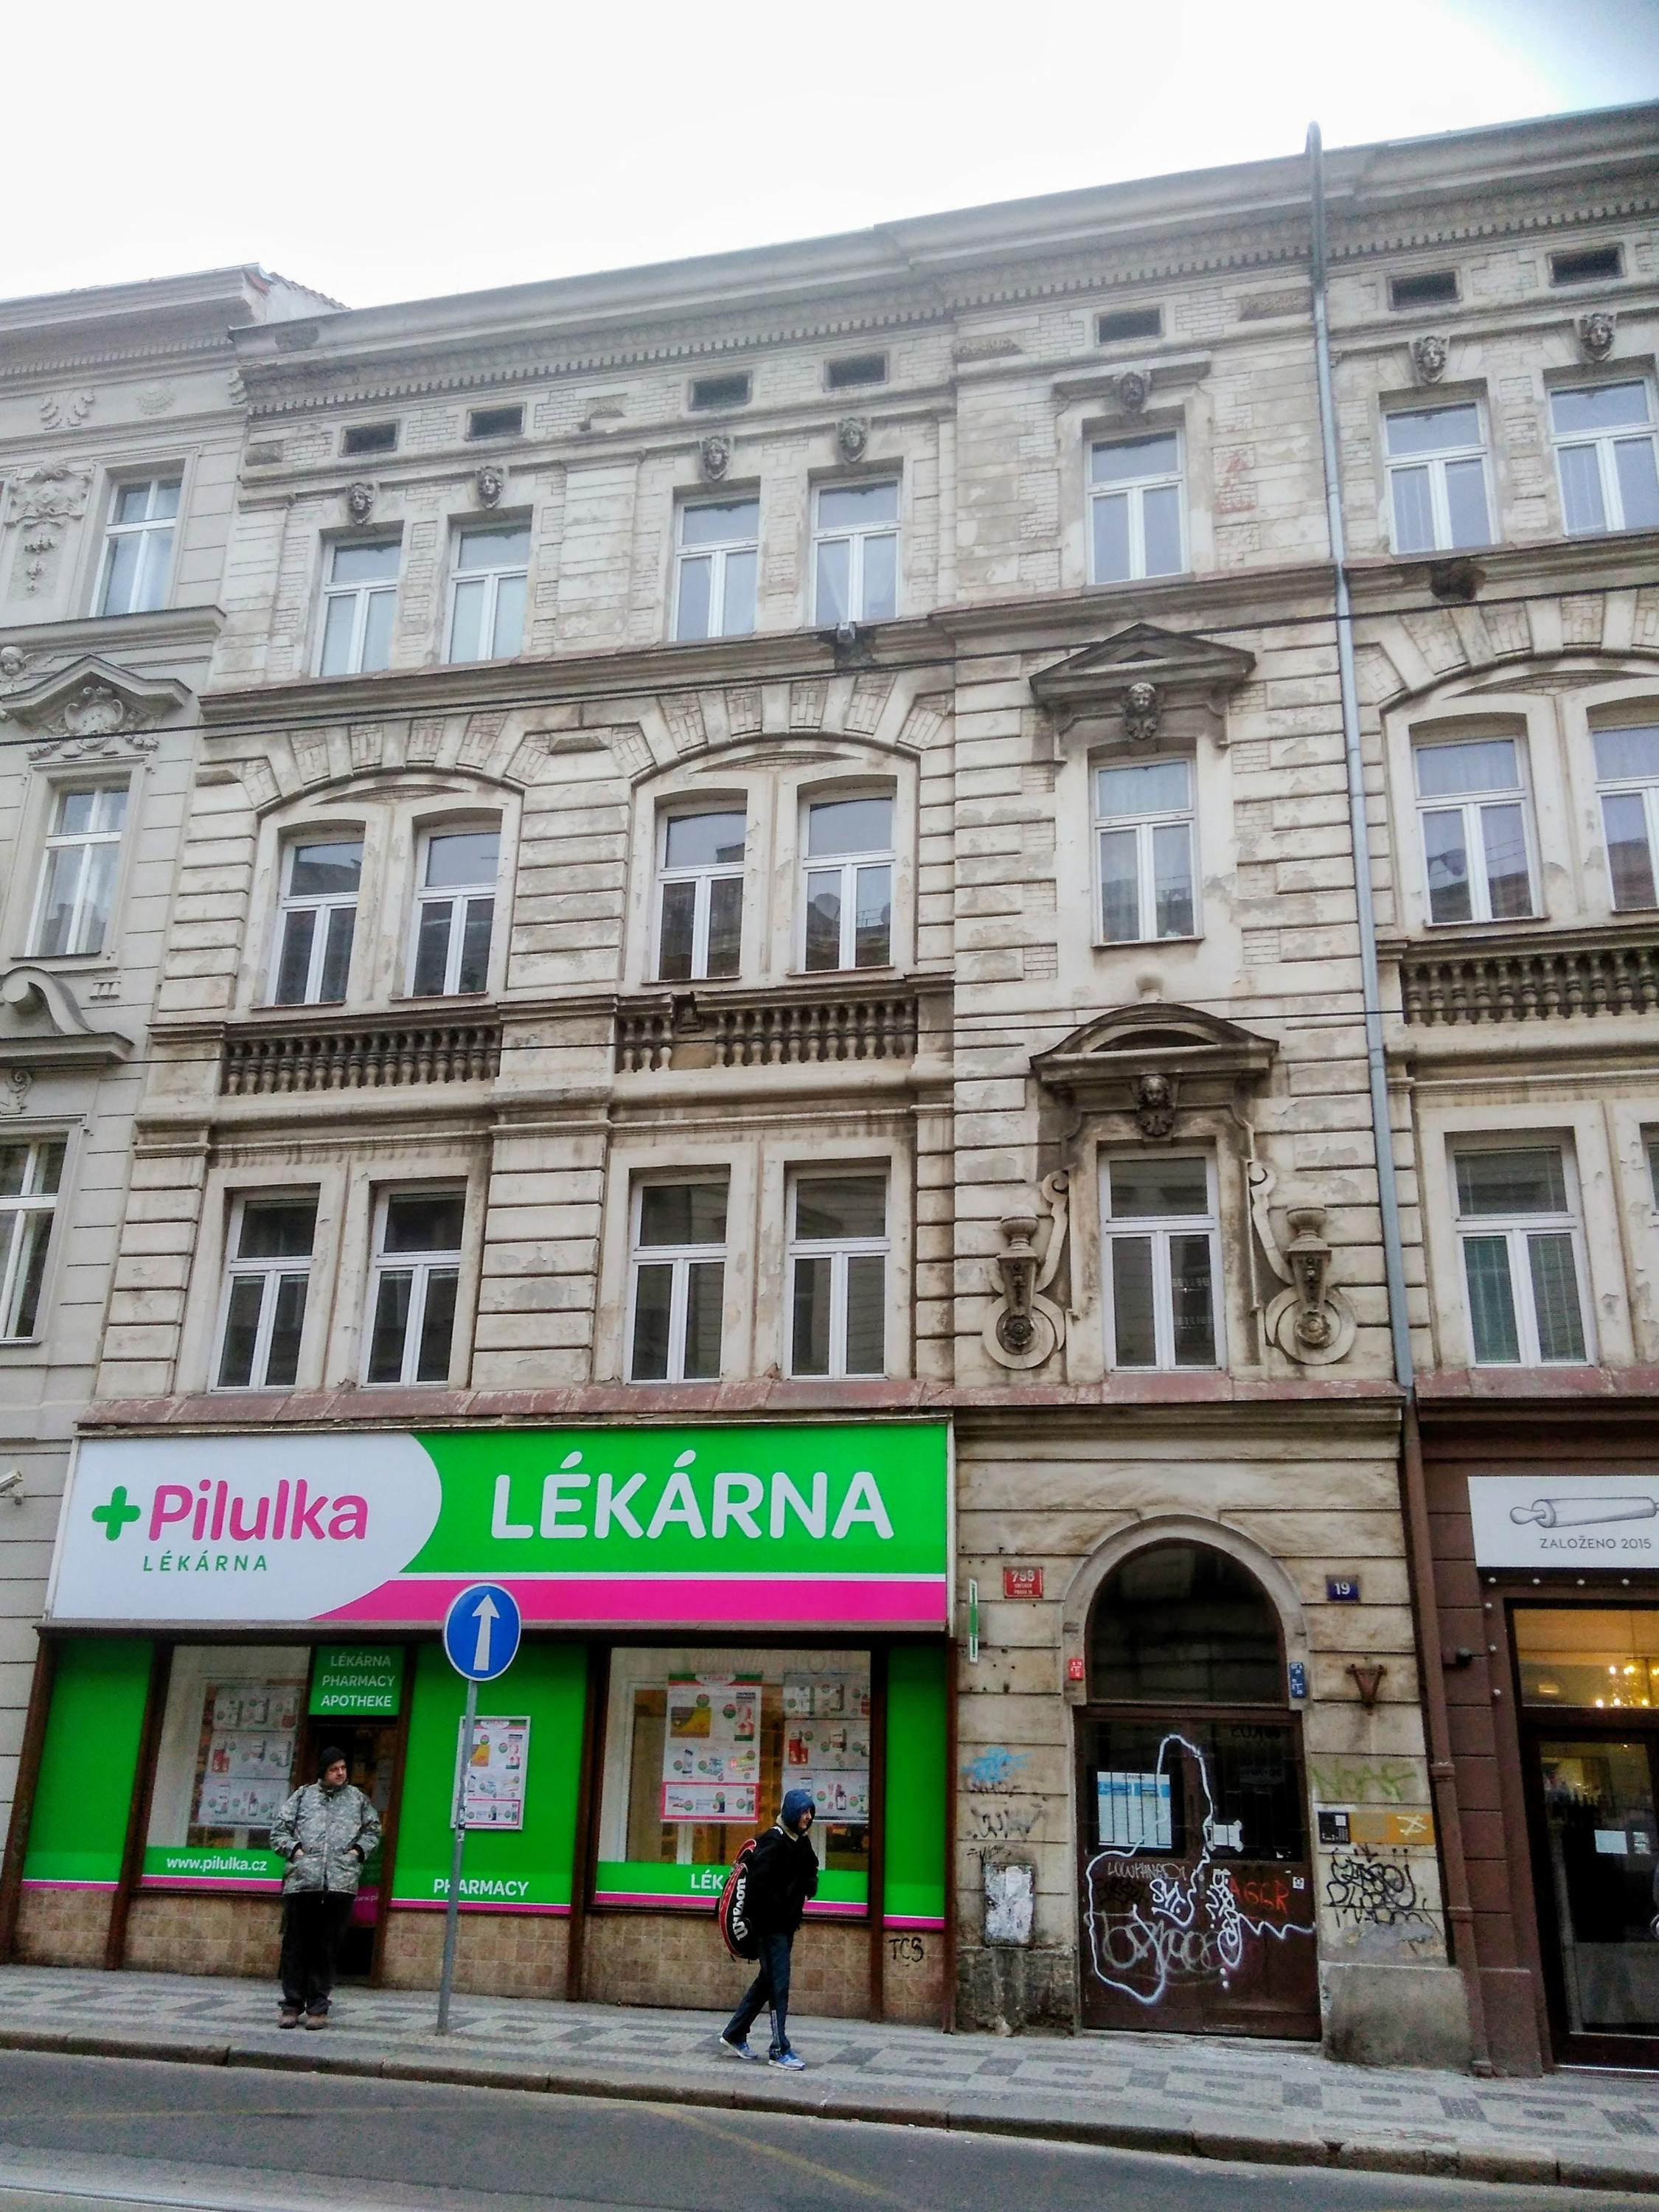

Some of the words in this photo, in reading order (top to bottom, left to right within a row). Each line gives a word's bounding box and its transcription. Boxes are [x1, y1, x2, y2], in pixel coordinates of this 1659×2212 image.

[490, 1449, 894, 1540] LÉKÁRNA
[148, 1478, 369, 1542] Pilulka
[1540, 1535, 1615, 1549] ZALOŽENO
[1621, 1538, 1652, 1549] 2015
[143, 1551, 268, 1571] LÉKÁRNA
[1335, 1582, 1351, 1595] 19
[330, 1652, 392, 1667] LÉKÁRNA
[322, 1675, 396, 1687] PHARMACY
[321, 1695, 393, 1707] APOTHEKE
[167, 1856, 268, 1873] www.pilulka.cz
[732, 1876, 748, 1941] Wilson
